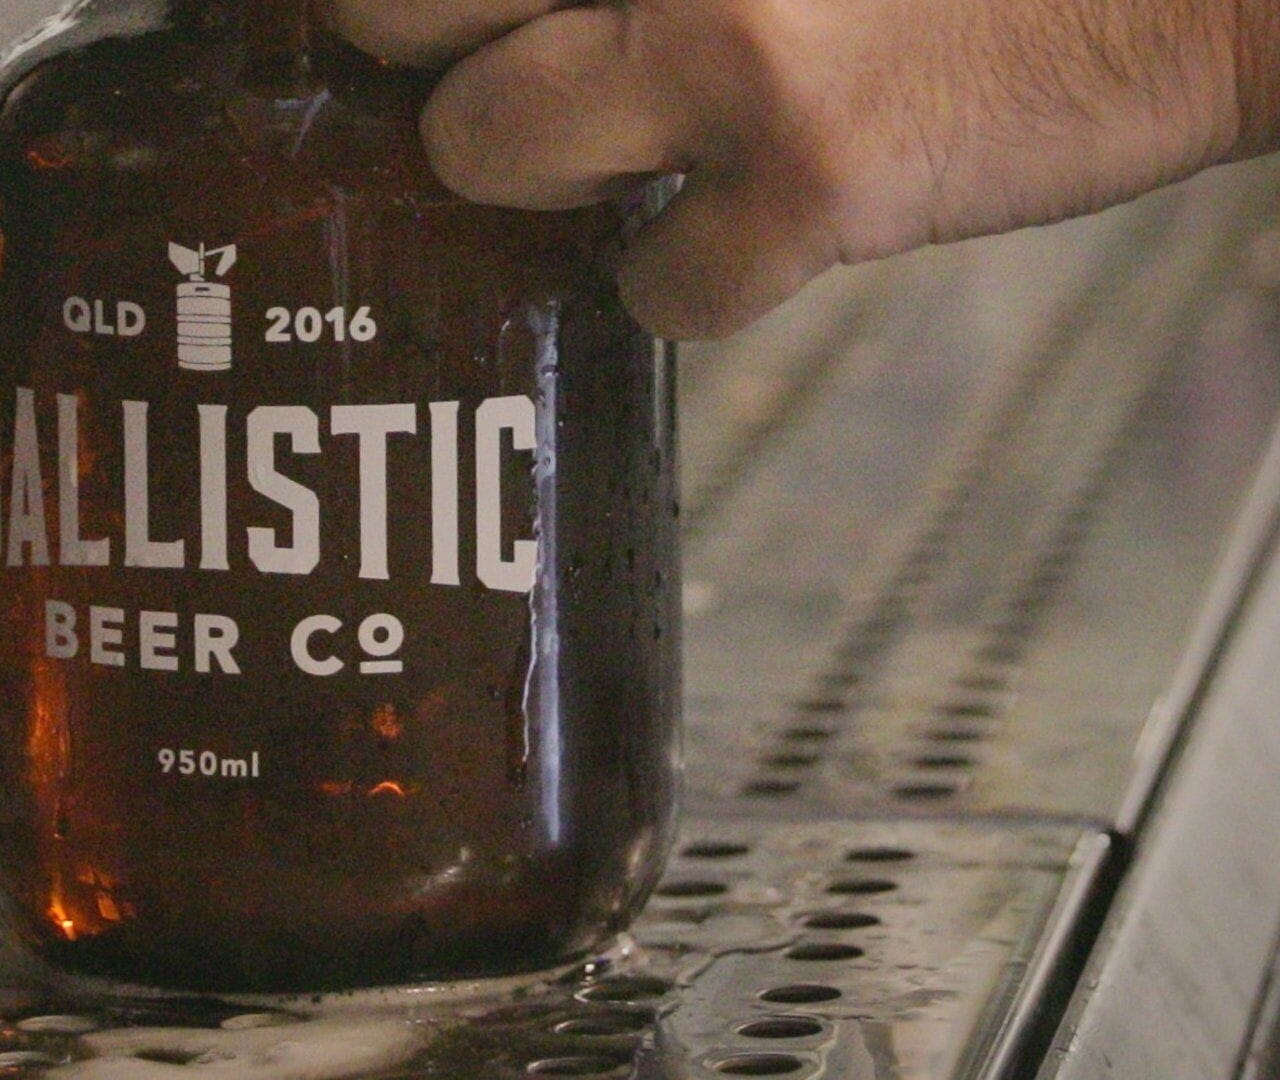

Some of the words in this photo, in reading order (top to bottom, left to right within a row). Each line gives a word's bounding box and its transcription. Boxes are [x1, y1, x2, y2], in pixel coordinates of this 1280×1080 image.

[62, 296, 146, 336] QLD
[265, 306, 377, 342] 2016
[45, 600, 241, 674] BEER
[157, 748, 260, 778] 950ml
